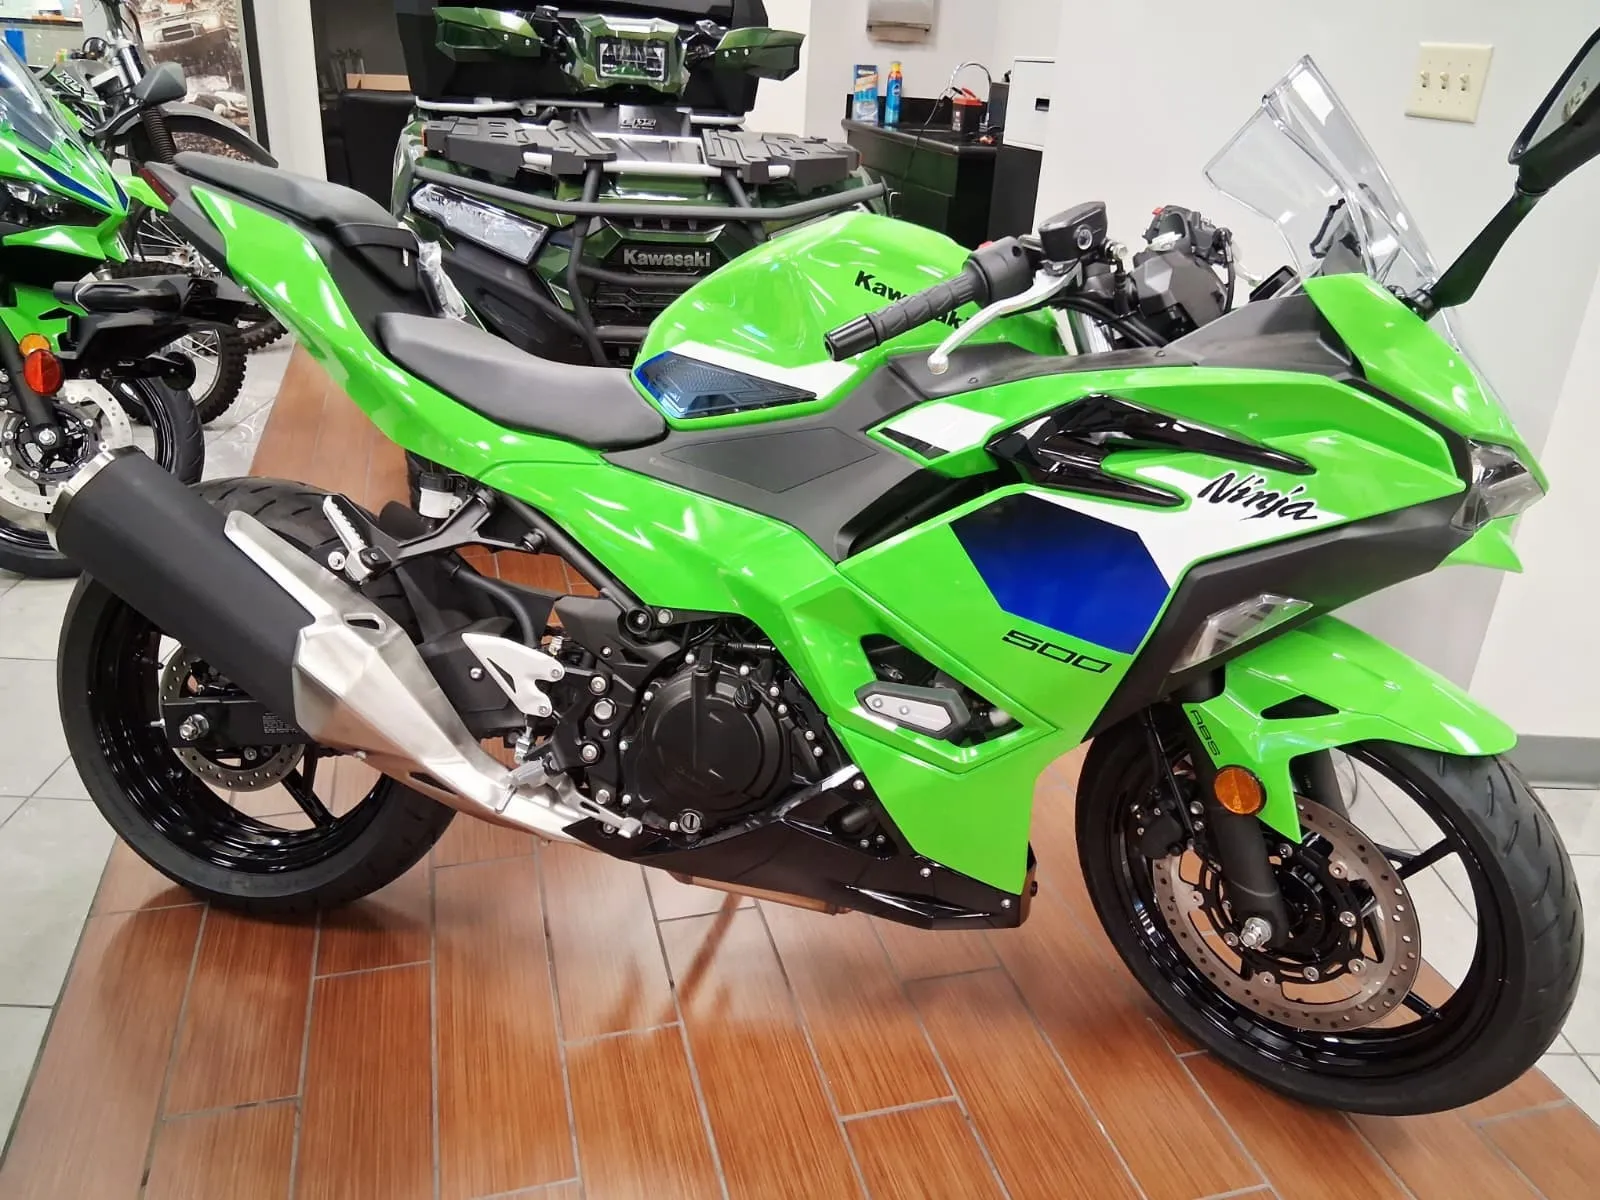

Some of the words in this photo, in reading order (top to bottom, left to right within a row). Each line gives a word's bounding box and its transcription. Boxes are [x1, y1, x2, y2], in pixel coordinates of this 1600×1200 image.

[623, 248, 711, 267] Kawasaki
[1197, 472, 1318, 521] Ninja
[1002, 630, 1112, 673] 500
[1190, 710, 1221, 756] ABS
